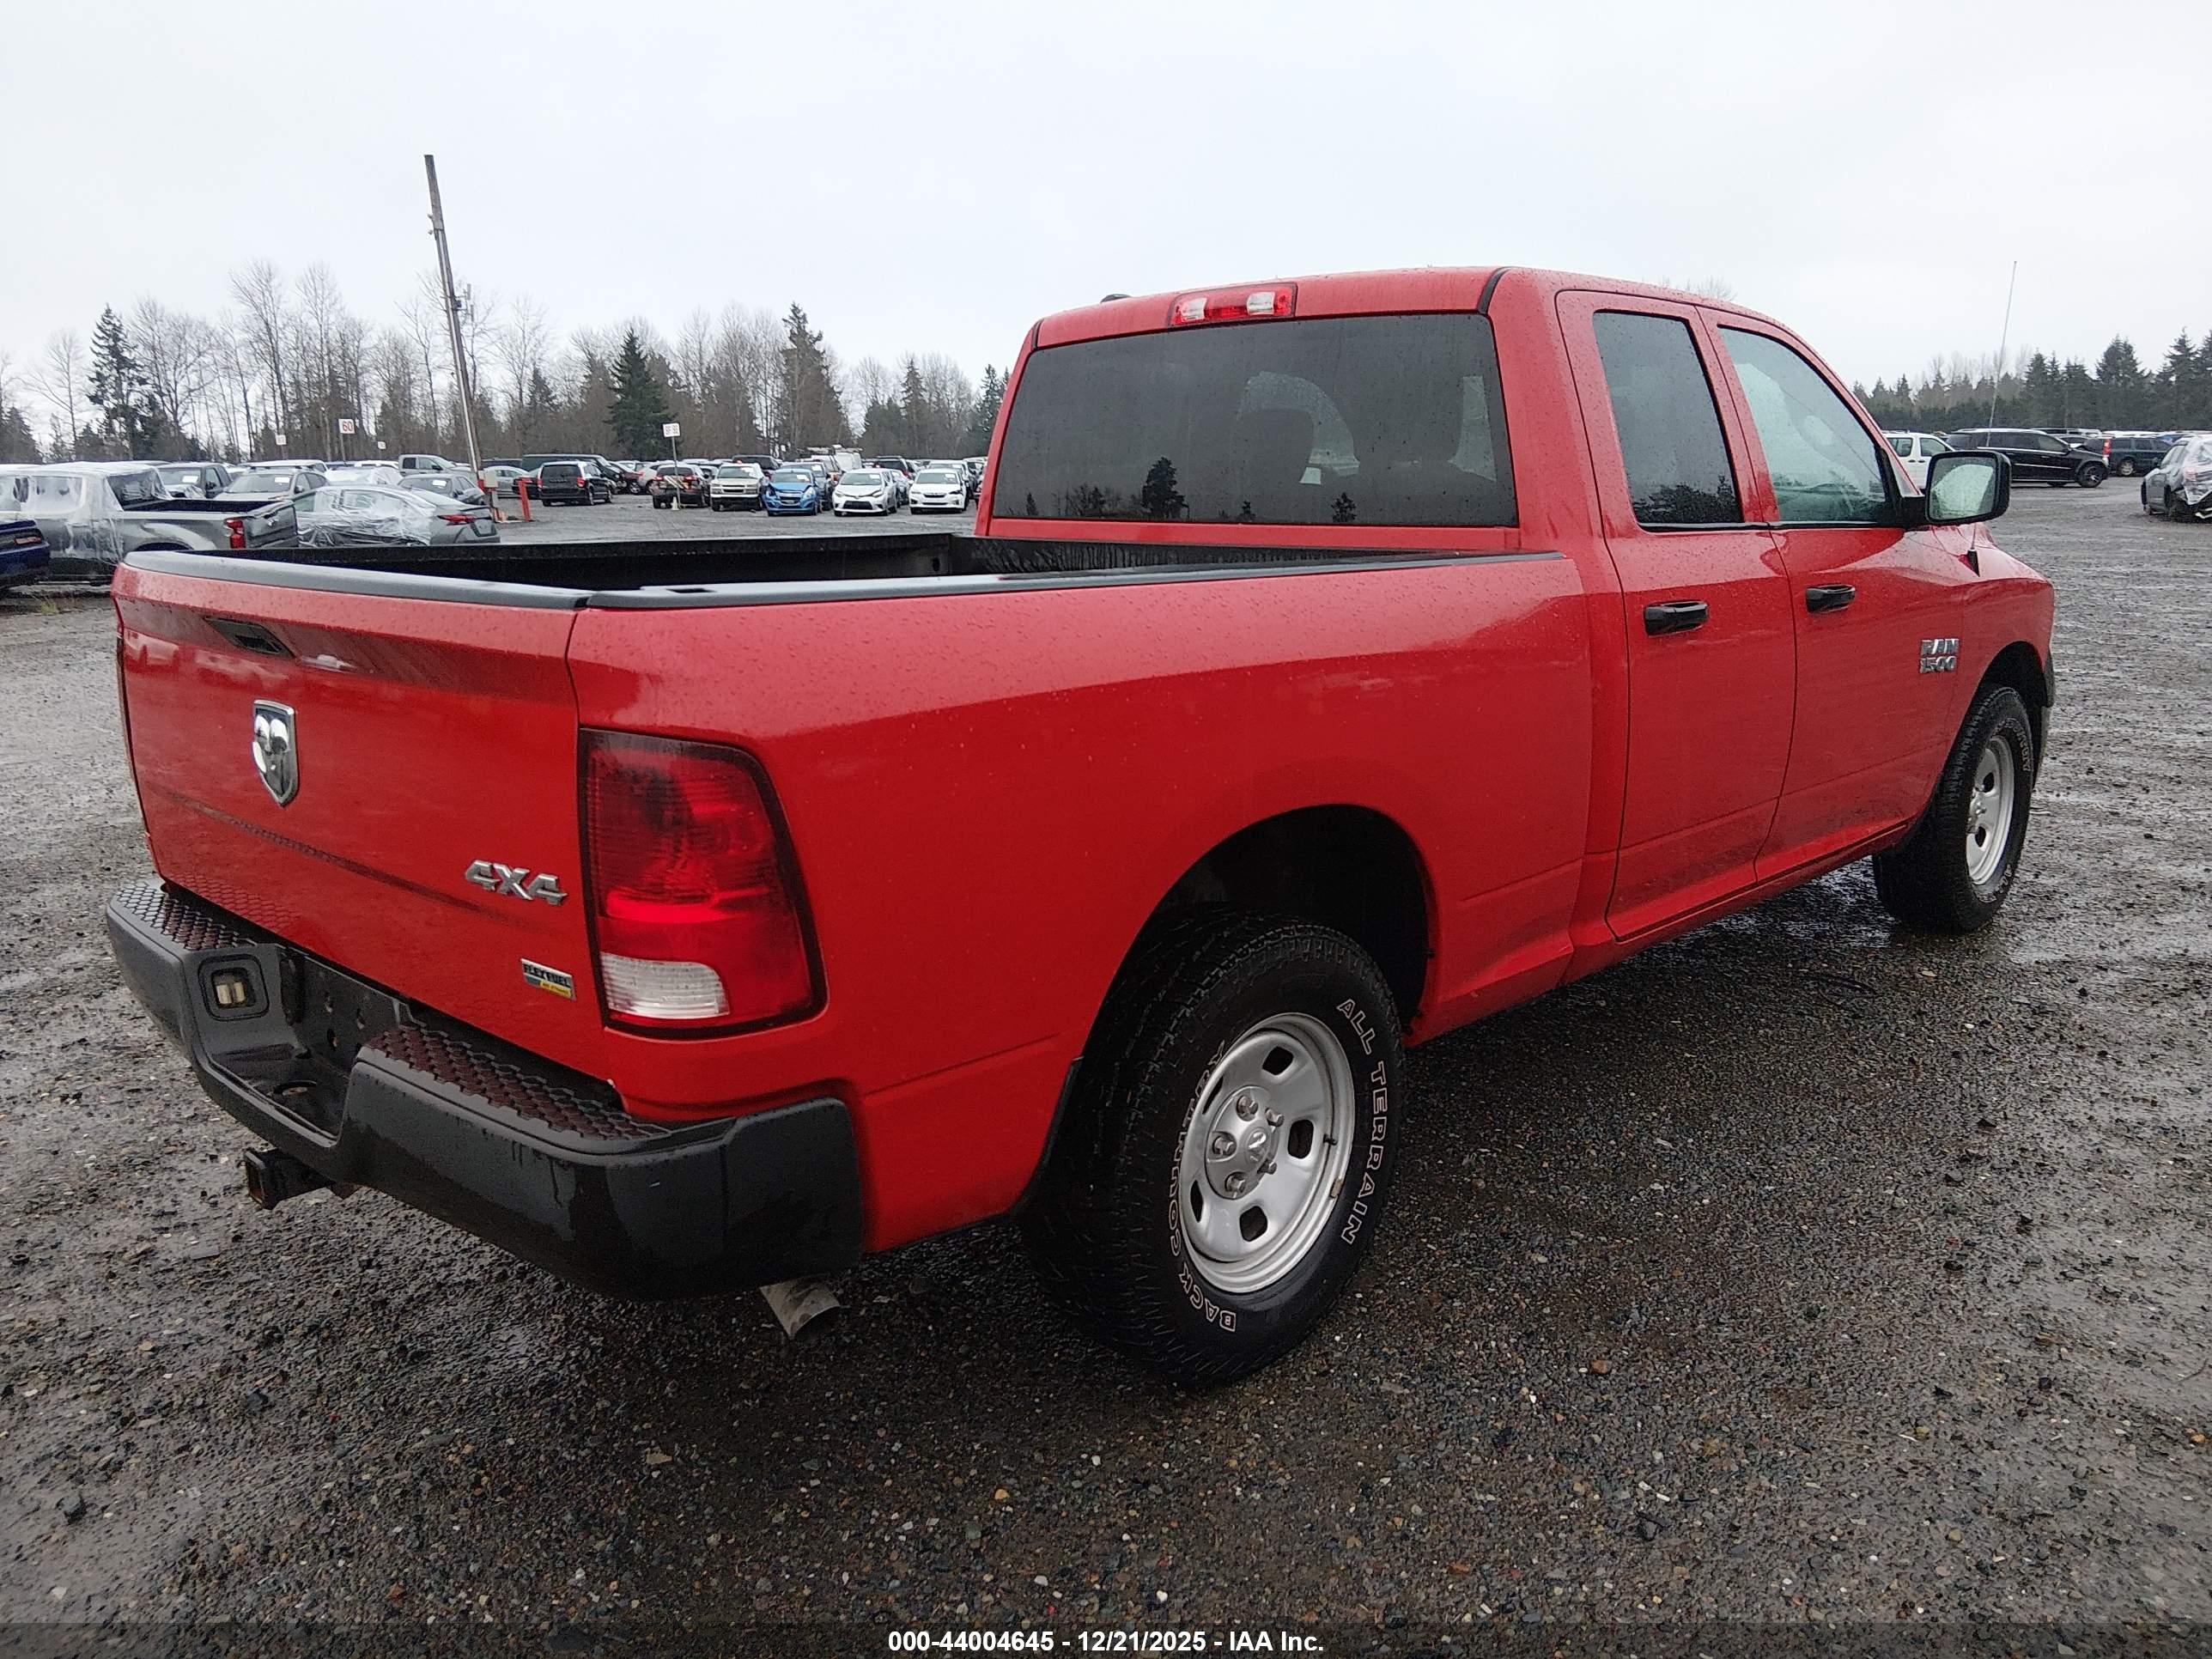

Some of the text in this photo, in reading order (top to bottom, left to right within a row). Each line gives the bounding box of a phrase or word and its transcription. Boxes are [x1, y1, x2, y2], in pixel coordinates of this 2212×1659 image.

[1919, 656, 1957, 674] 1500
[1336, 999, 1388, 1244] ALL TERRAIN
[1178, 1261, 1236, 1333] BACK
